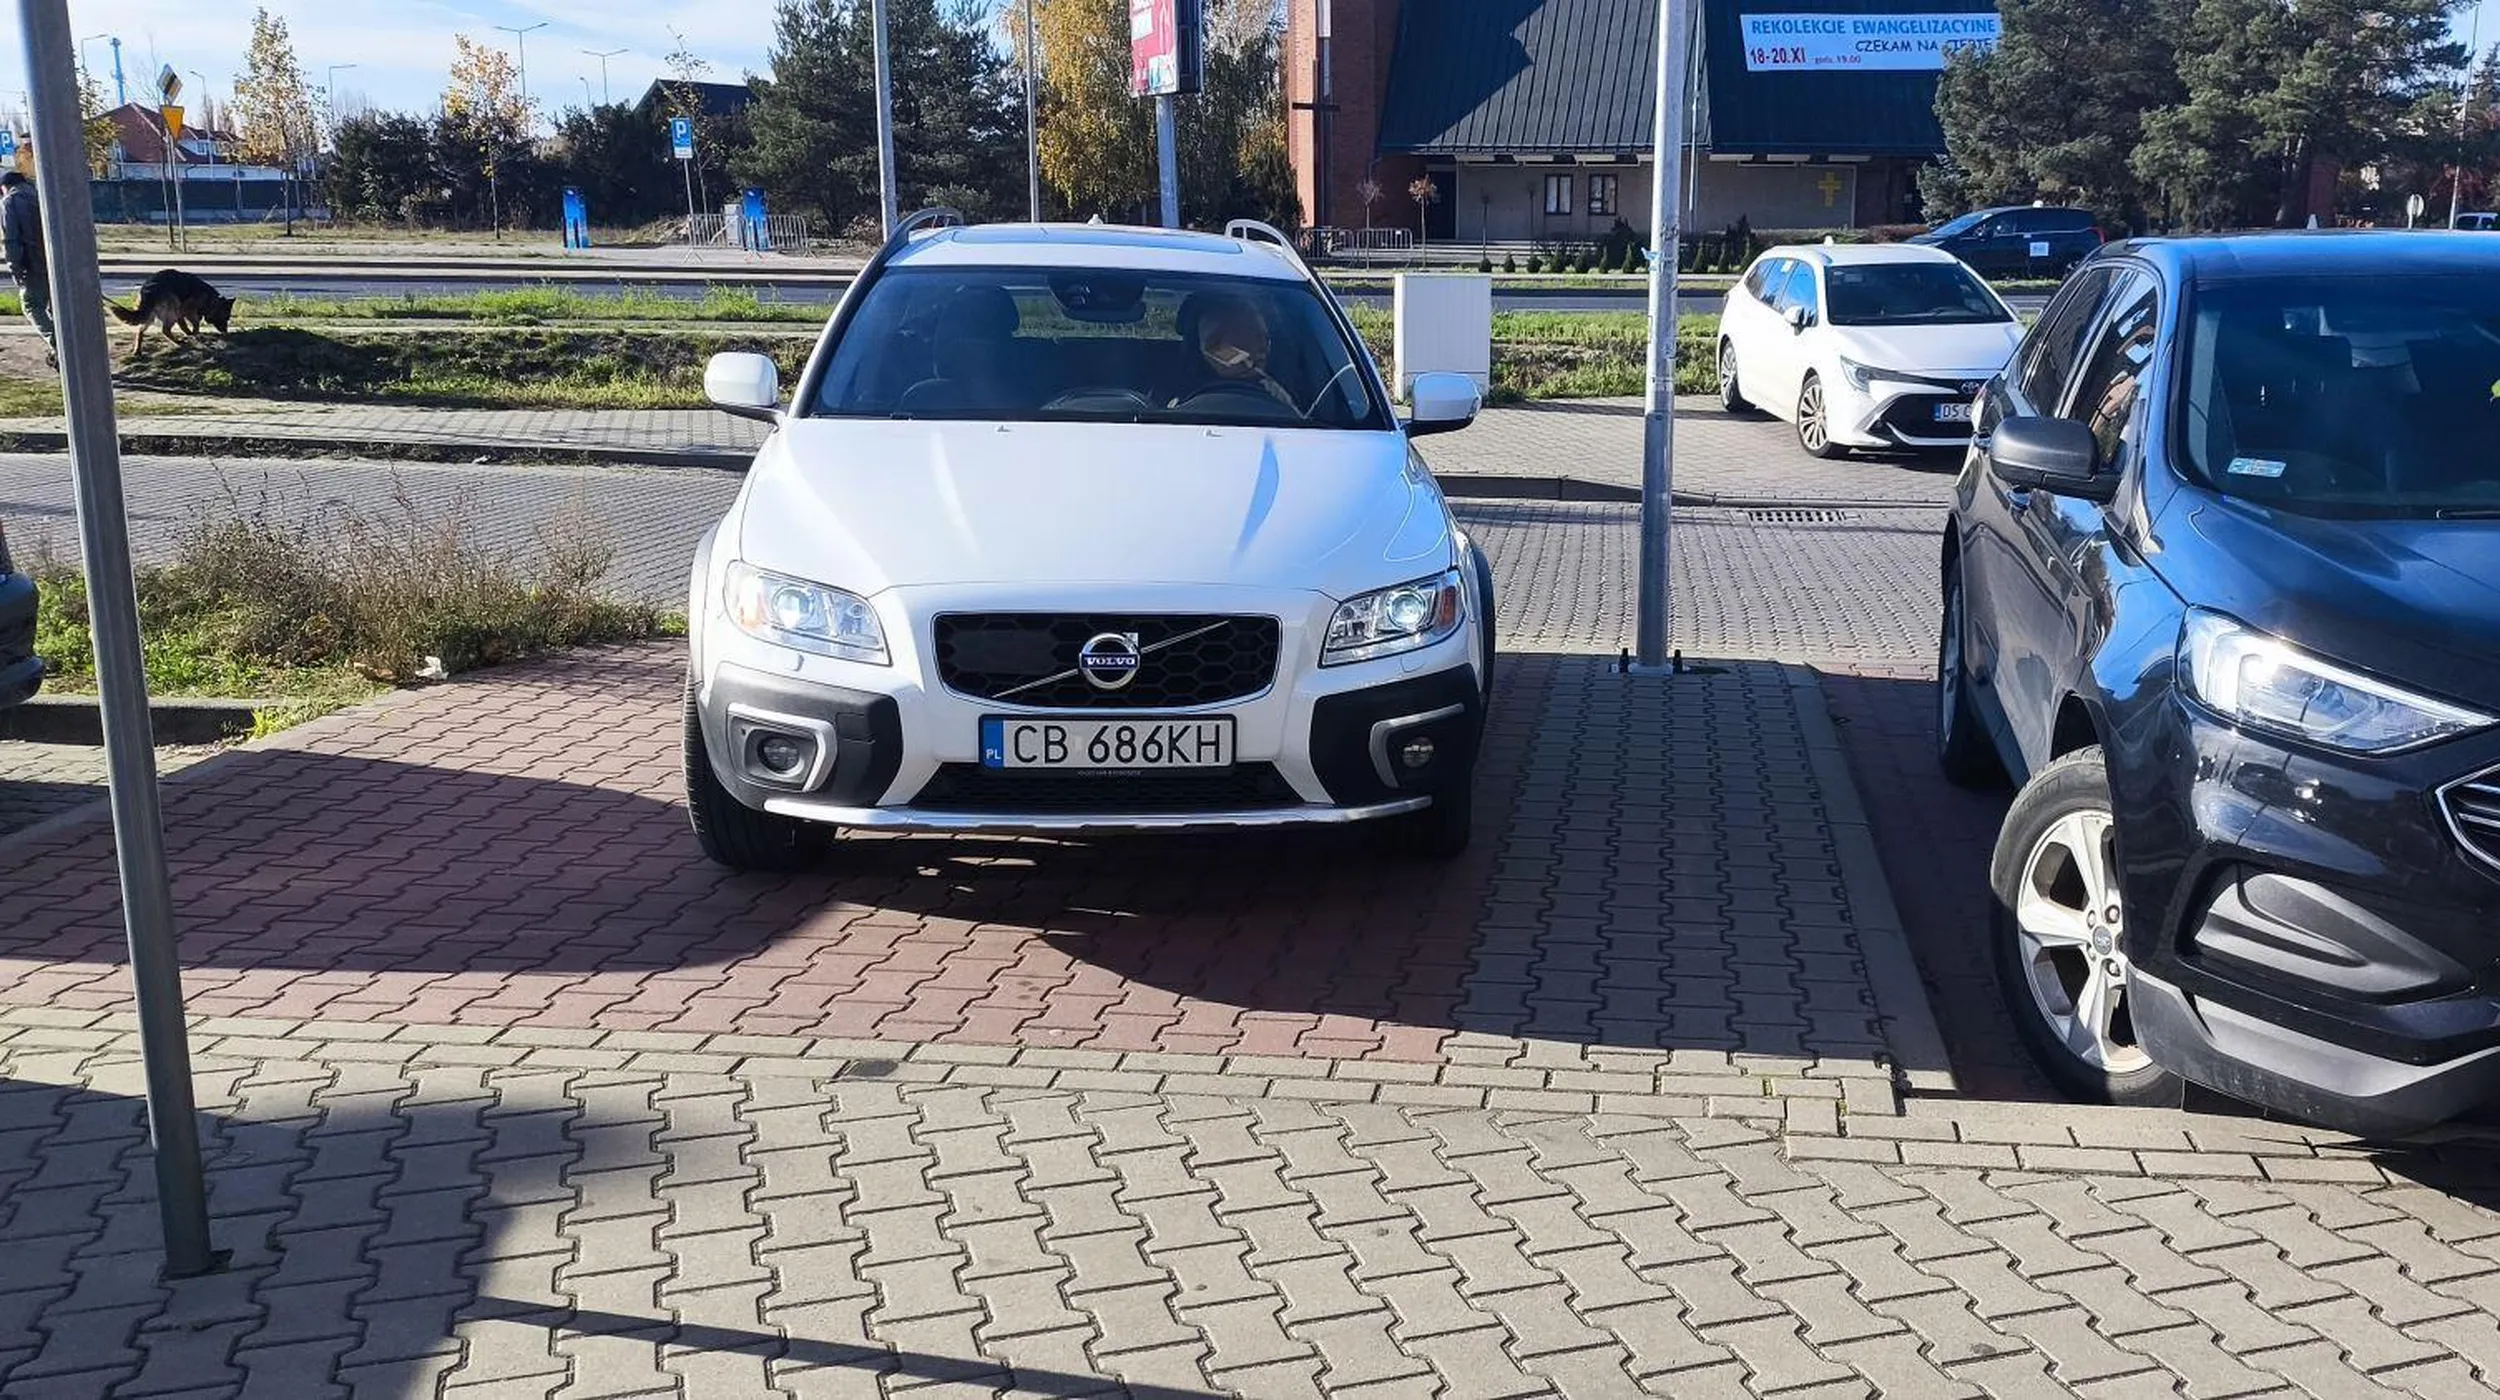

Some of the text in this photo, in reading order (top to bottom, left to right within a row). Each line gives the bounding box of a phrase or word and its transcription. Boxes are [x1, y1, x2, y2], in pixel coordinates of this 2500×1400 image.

[1752, 18, 1996, 34] REKOLEKCJE EWANGELIZACYJNE
[1855, 39, 1913, 52] CZEKAM
[1917, 39, 1939, 52] NA
[1750, 47, 1807, 64] 18-20.XI
[675, 121, 686, 138] P
[1084, 656, 1137, 666] VOLVO
[1013, 724, 1221, 765] CB 686KH
[985, 748, 1002, 760] PL
